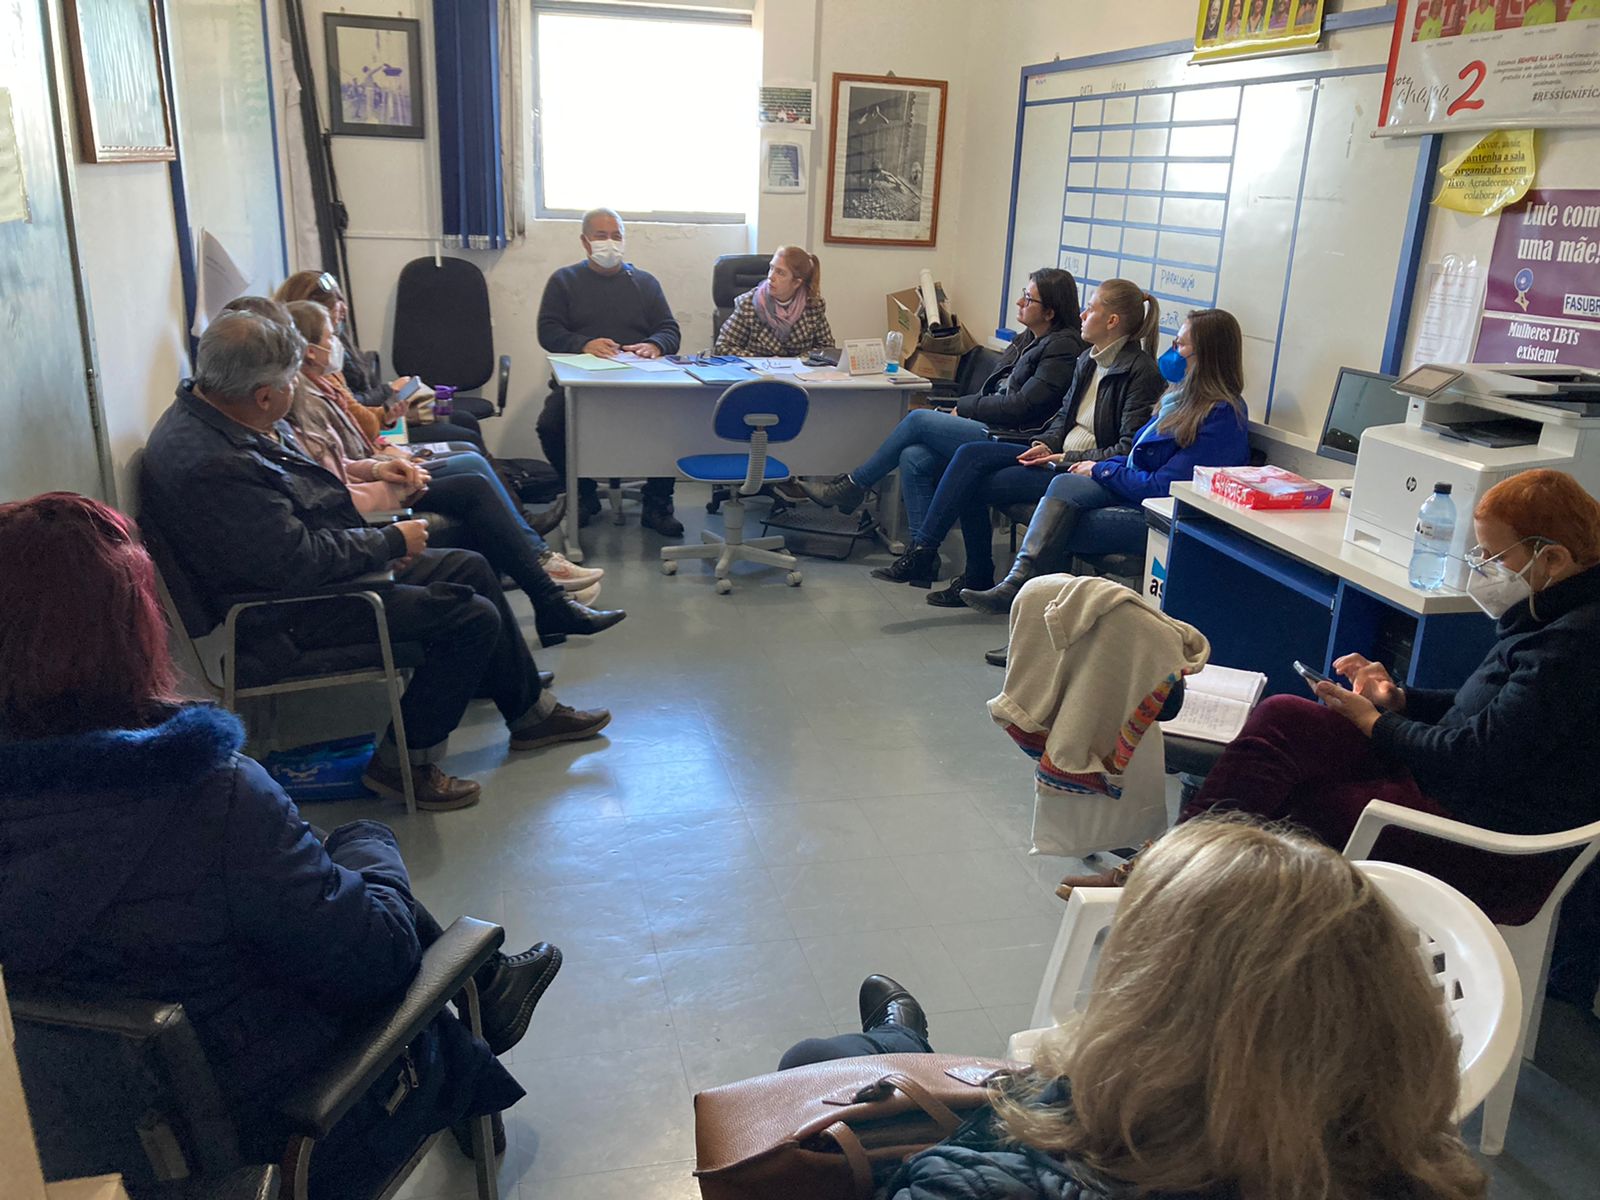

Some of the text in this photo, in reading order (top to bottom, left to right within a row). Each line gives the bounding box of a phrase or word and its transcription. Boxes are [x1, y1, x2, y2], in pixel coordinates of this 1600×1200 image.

[1446, 60, 1487, 117] 2
[1464, 151, 1502, 162] antenha
[1510, 150, 1525, 161] sala
[1455, 164, 1502, 177] organizada
[1510, 166, 1527, 175] sem
[1523, 201, 1559, 227] Lute
[1518, 235, 1600, 264] uma mãe!
[1508, 321, 1580, 345] Mulheres LBTs
[1516, 344, 1559, 363] existem!
